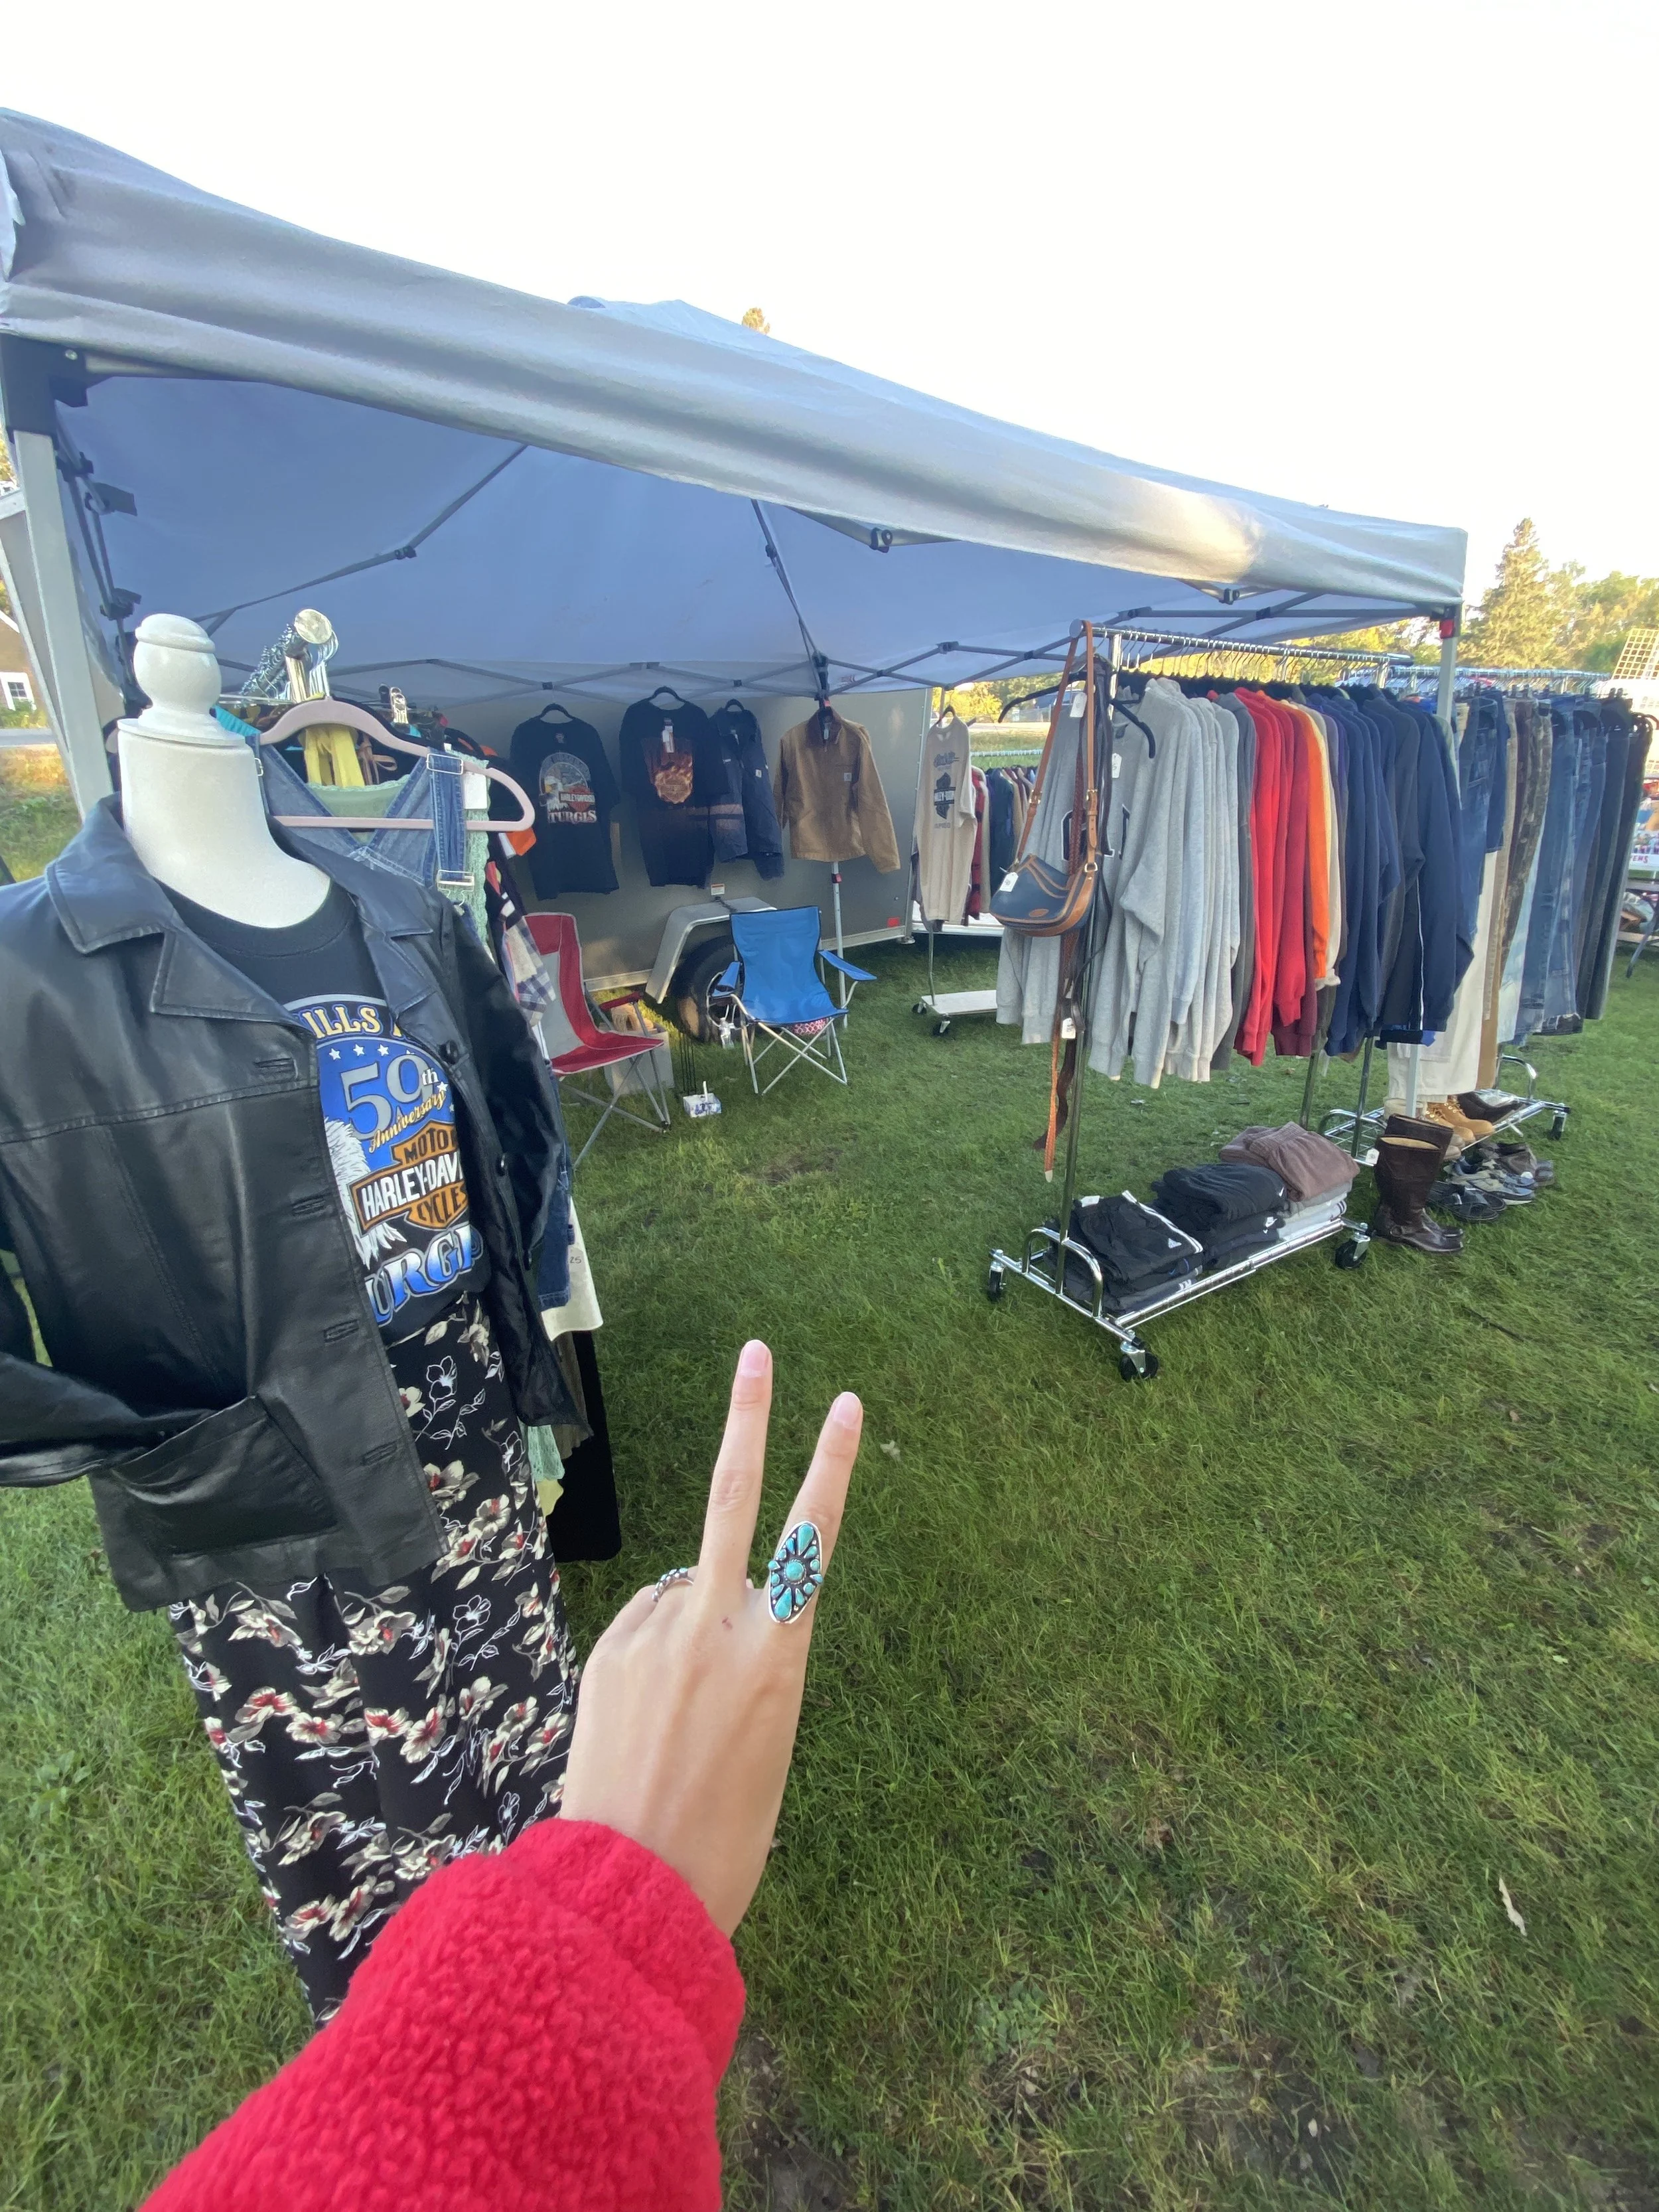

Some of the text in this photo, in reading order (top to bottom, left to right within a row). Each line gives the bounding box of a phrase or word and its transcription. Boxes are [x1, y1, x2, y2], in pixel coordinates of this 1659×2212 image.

[302, 1006, 380, 1039] ILLS
[369, 1090, 446, 1153] Anniversary
[362, 1152, 463, 1221] HARLEY-DAVI
[417, 1186, 465, 1224] CYCLE
[569, 1256, 582, 1264] 25
